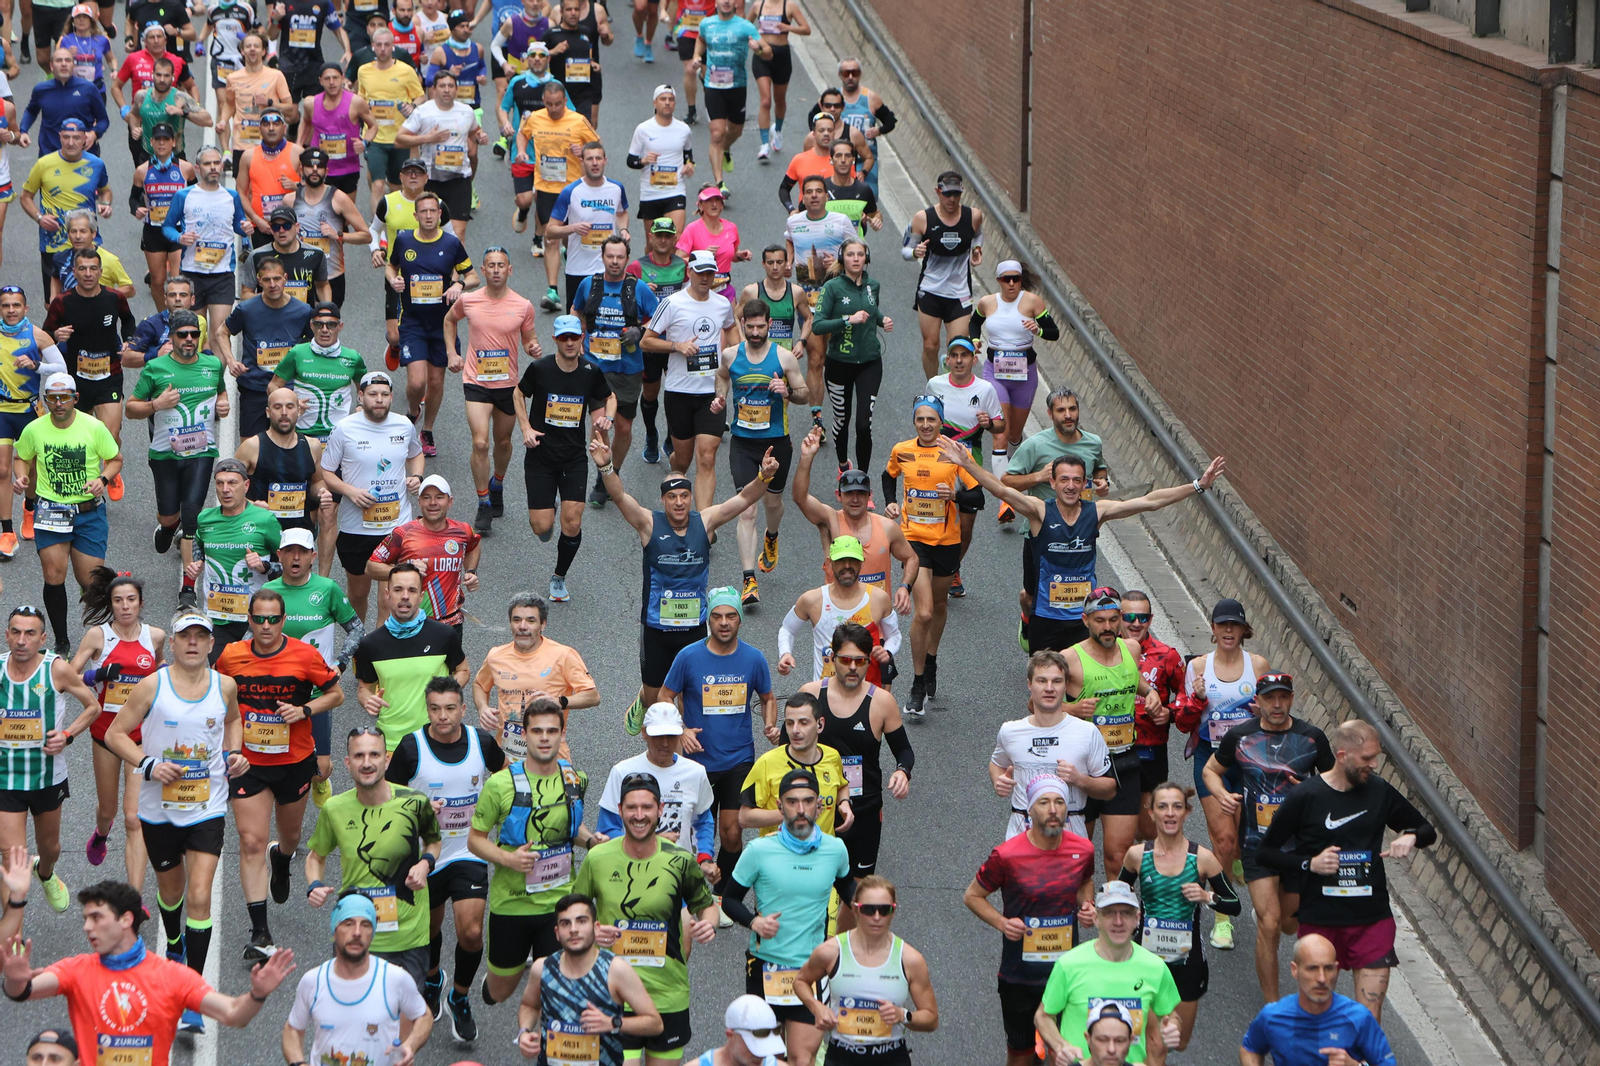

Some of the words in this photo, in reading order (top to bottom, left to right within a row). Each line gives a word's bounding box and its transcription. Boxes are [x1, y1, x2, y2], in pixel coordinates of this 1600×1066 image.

[718, 688, 733, 696] 4857
[450, 797, 474, 806] ZURICH
[542, 846, 566, 858] ZURICH
[1157, 934, 1177, 944] 10145
[114, 1037, 147, 1046] ZURICH
[562, 1040, 580, 1048] 4831
[836, 1041, 866, 1054] PRO
